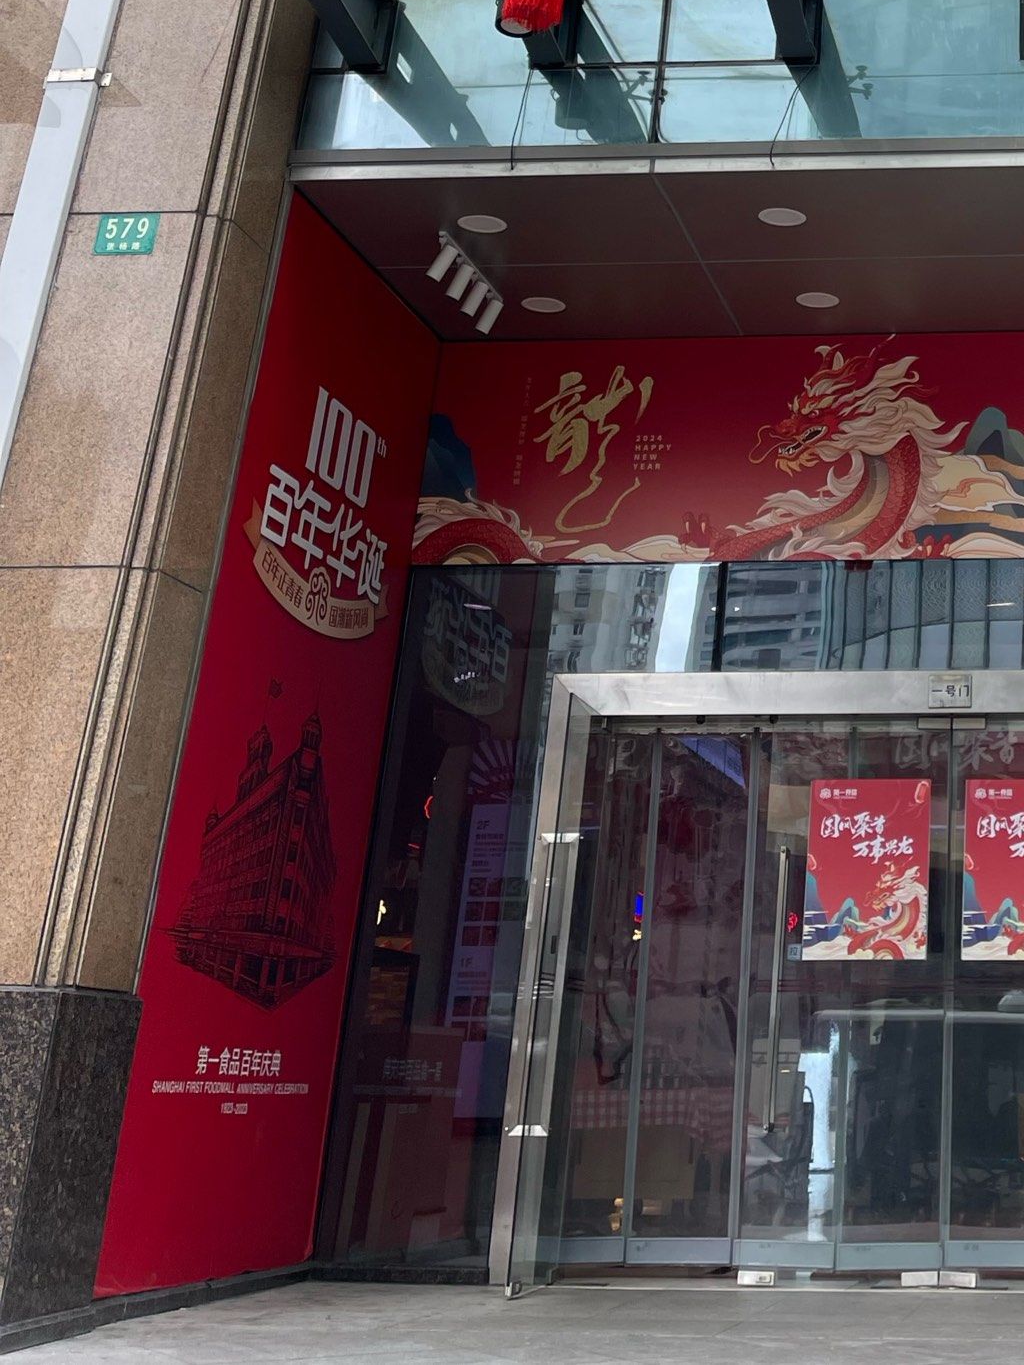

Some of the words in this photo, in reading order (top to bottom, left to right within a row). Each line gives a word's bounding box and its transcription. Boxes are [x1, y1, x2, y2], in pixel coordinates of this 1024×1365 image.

[105, 217, 149, 239] 579
[635, 434, 663, 442] 2024
[634, 443, 672, 452] HAPPY
[633, 453, 658, 461] NEW
[633, 462, 662, 471] YEAR
[260, 463, 388, 605] 百年华诞
[261, 546, 304, 609] 百年正青春
[931, 684, 970, 697] 一号门
[476, 819, 490, 830] 2F
[852, 834, 914, 865] 万事兴龙
[195, 1045, 282, 1077] 第一食品百年庆典
[152, 1080, 185, 1094] SHANGHAI
[185, 1081, 205, 1093] FIRST
